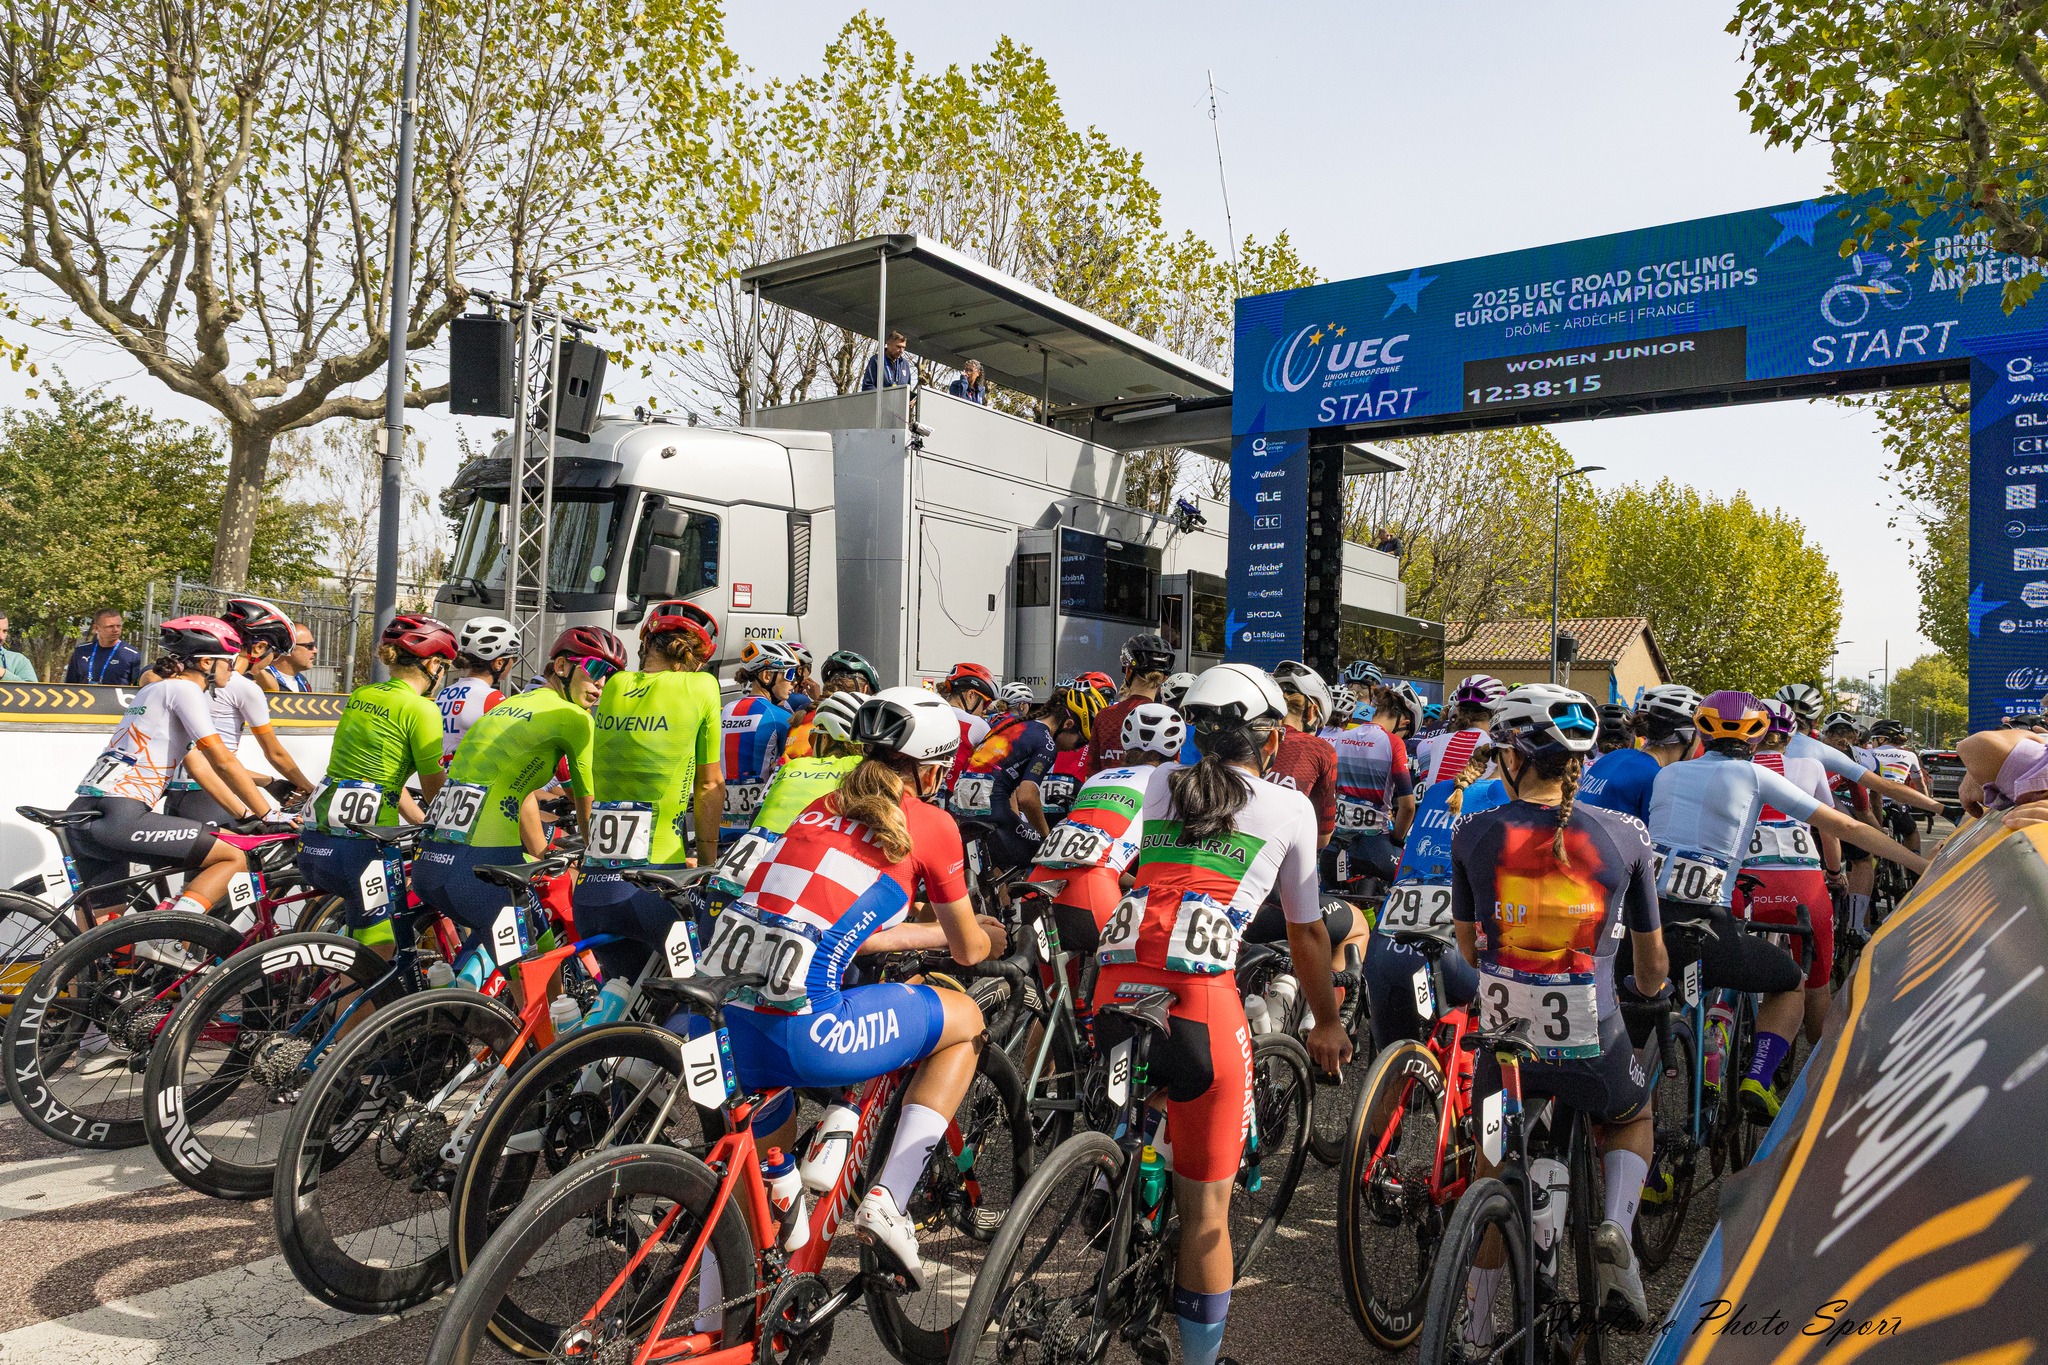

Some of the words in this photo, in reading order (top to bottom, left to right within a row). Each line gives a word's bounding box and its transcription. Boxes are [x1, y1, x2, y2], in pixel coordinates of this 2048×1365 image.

[1472, 287, 1519, 308] 2025
[1525, 280, 1566, 299] UEC
[1571, 269, 1632, 293] ROAD
[1638, 253, 1736, 281] CYCLING
[1455, 298, 1563, 327] EUROPEAN
[1568, 267, 1759, 311] CHAMPIONSHIPS
[1505, 320, 1551, 338] DRÔME
[1563, 310, 1626, 330] ARDÈCHE
[1638, 301, 1695, 319] FRANCE
[1327, 334, 1411, 371] UEC
[1506, 352, 1596, 373] WOMEN
[1602, 340, 1696, 362] JUNIOR
[1808, 320, 1959, 367] START
[1325, 371, 1349, 381] UNION
[1333, 376, 1371, 387] CYCLISME
[1467, 375, 1602, 404] 12:38:15
[1317, 386, 1418, 423] START
[745, 626, 784, 640] PORTIX
[1261, 630, 1286, 639] Région
[438, 686, 472, 700] POR
[596, 711, 669, 732] SLOVENIA
[721, 718, 752, 729] sazka
[1358, 708, 1371, 718] EY
[508, 755, 541, 792] Telekom
[338, 791, 377, 824] 96
[446, 788, 481, 827] 95
[969, 781, 981, 807] 2
[131, 828, 199, 843] CYPRUS
[599, 814, 640, 855] 97
[1060, 832, 1099, 860] 69
[1793, 829, 1808, 854] 8
[1142, 834, 1246, 865] BULGARIA
[46, 868, 65, 887] 71
[233, 881, 251, 902] 96
[365, 876, 384, 898] 95
[1673, 863, 1724, 903] 104
[1386, 891, 1422, 925] 29
[1429, 890, 1454, 925] 2
[1494, 901, 1528, 924] ESP
[1568, 902, 1595, 915] GOBIK
[1753, 894, 1799, 904] POLSKA
[497, 926, 516, 947] 97
[703, 915, 756, 976] 70
[670, 941, 690, 968] 94
[762, 933, 804, 996] 70
[1417, 981, 1428, 1004] 29
[1686, 970, 1697, 998] 104
[1541, 991, 1571, 1042] 3
[809, 1008, 901, 1055] CROATIA
[1548, 1049, 1571, 1058] CIC
[690, 1053, 718, 1088] 70
[1112, 1057, 1129, 1087] 68
[1235, 1025, 1251, 1143] BULGARIA
[15, 1058, 112, 1142] BLACK
[1486, 1120, 1500, 1135] 3
[566, 1168, 596, 1190] CORSA
